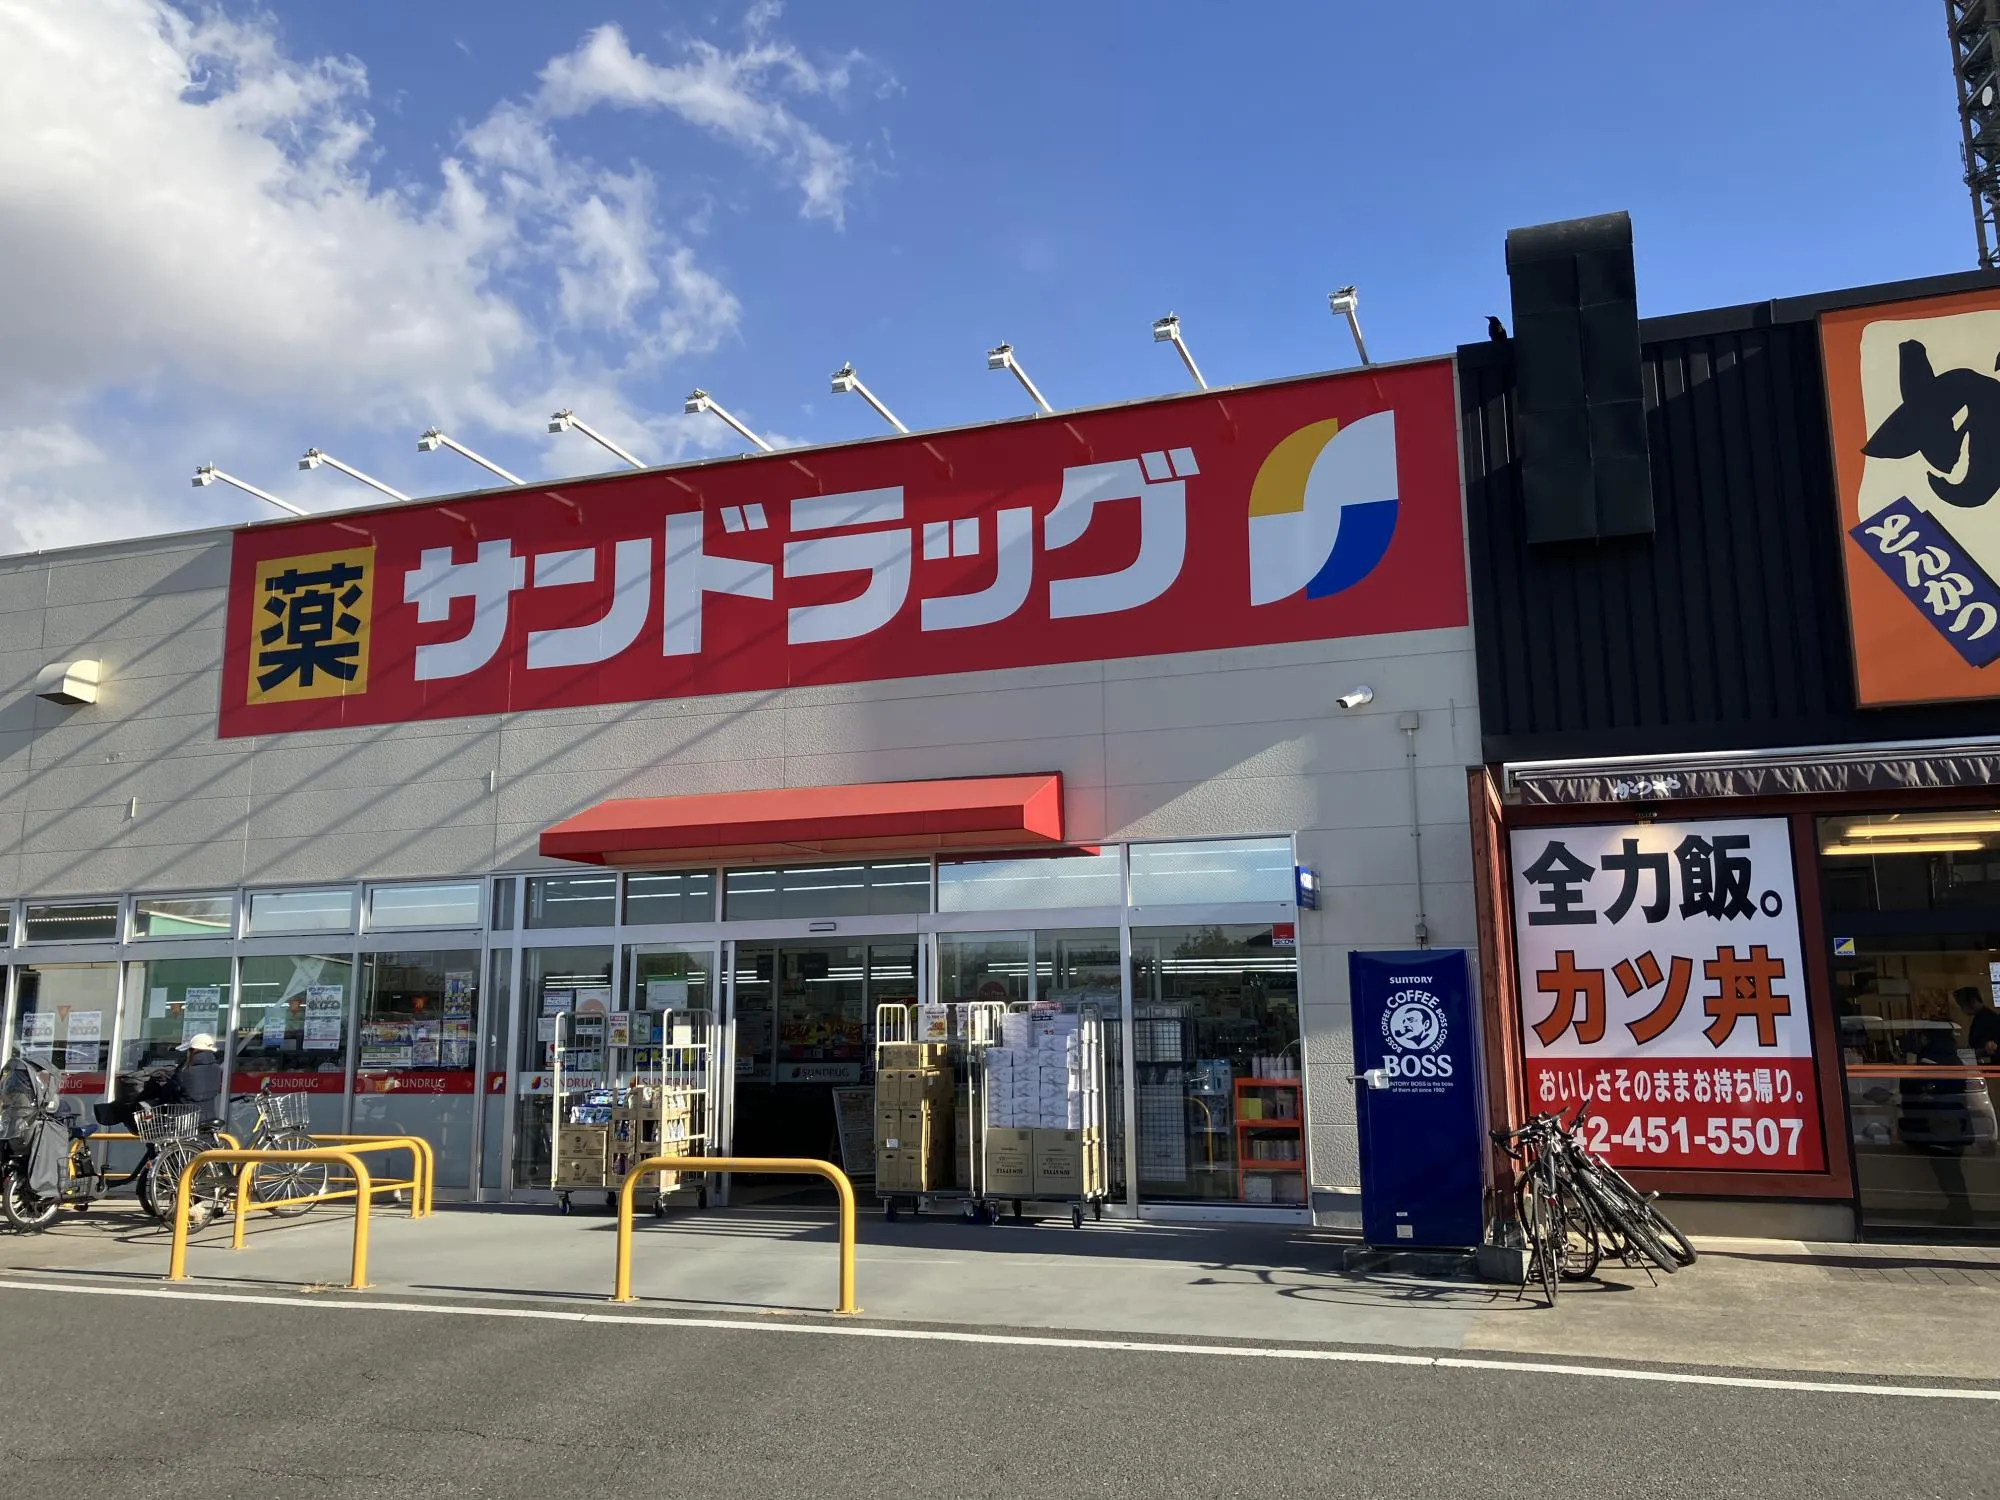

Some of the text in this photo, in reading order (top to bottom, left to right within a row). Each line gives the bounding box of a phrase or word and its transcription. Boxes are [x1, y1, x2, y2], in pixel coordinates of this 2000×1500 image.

[403, 446, 1201, 683] サンドラッグ
[1865, 514, 1998, 641] とんかつ
[258, 562, 363, 696] 薬
[1523, 834, 1783, 926] 全力飯。
[1386, 989, 1440, 1009] COFFEE
[1389, 976, 1433, 984] SUNTORY
[1531, 944, 1791, 1049] カツ丼
[1381, 1008, 1403, 1053] BOSS COFFEE
[1430, 1008, 1448, 1053] BOSS COFFEE
[58, 1079, 83, 1089] DRUG
[271, 1078, 319, 1088] SUNDRUG
[396, 1078, 446, 1088] SUNDRUG
[1382, 1054, 1453, 1077] BOSS
[1539, 1068, 1804, 1105] おいしさそのままお持ち帰り。
